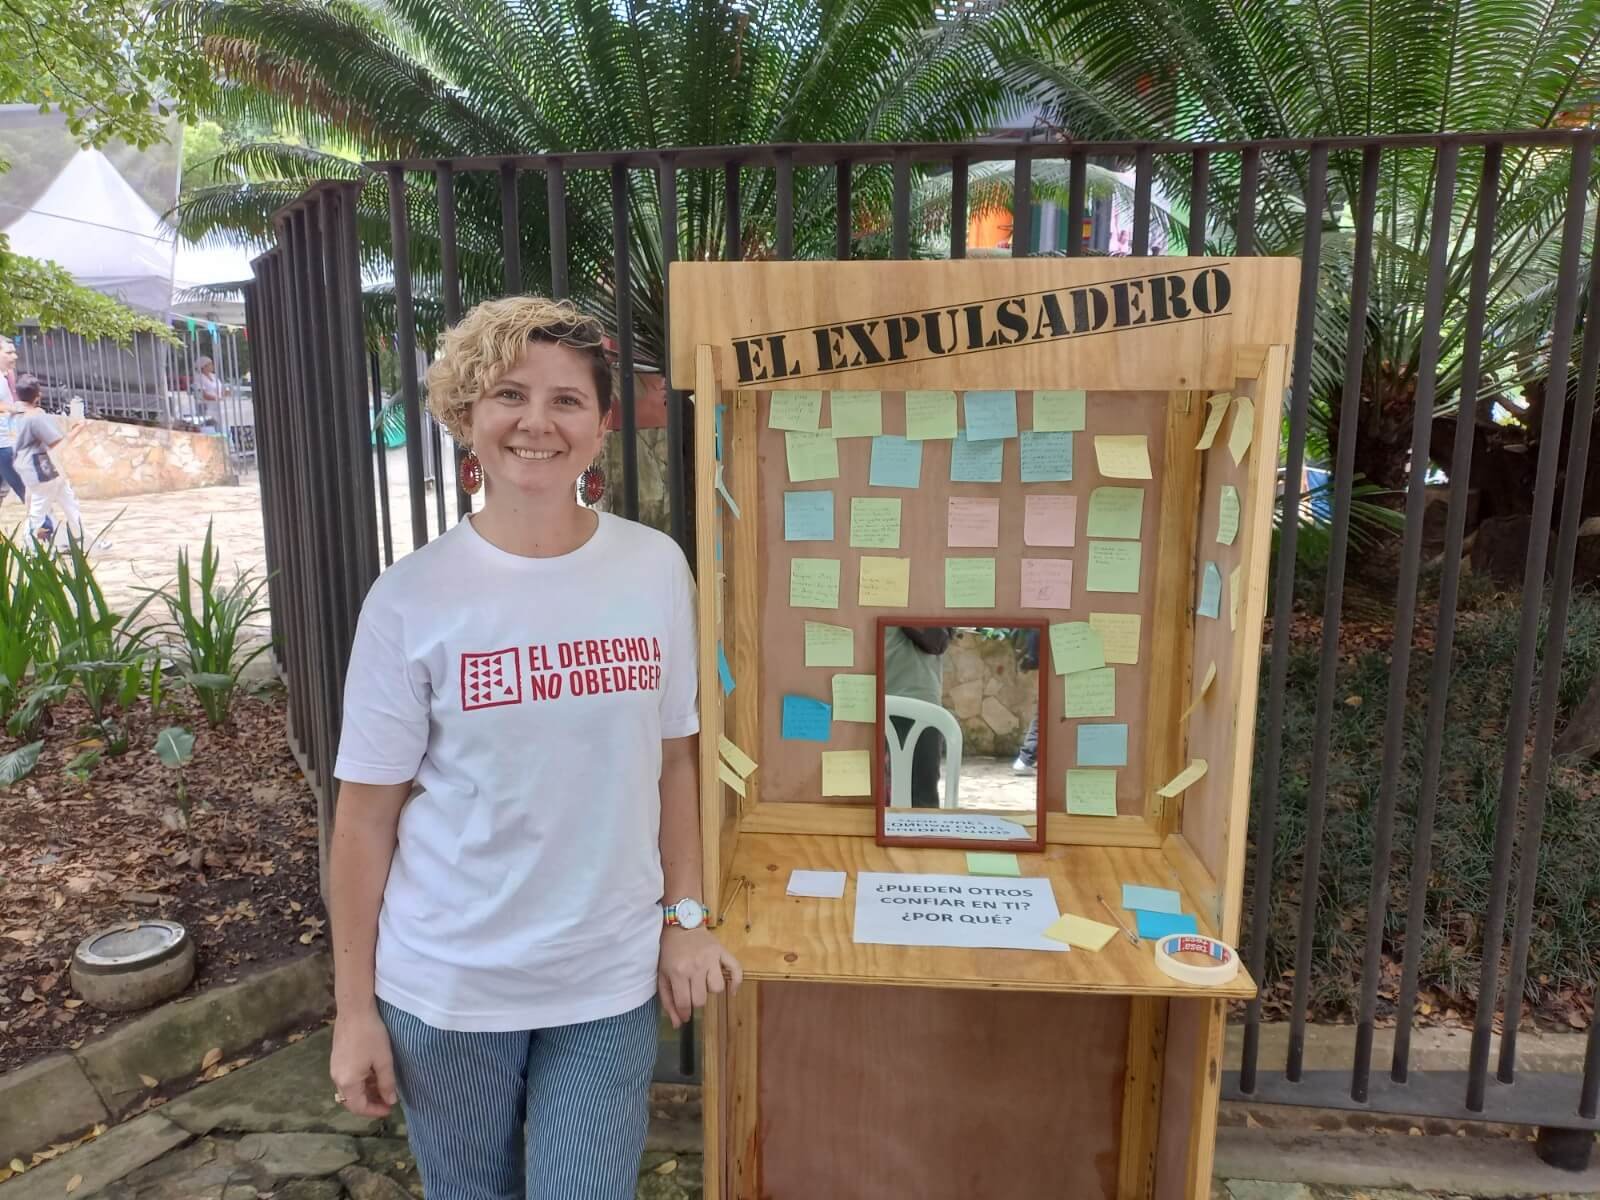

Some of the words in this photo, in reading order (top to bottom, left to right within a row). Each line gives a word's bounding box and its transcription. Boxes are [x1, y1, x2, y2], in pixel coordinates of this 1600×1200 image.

[732, 335, 801, 382] EL
[813, 268, 1232, 371] EXPULSADERO
[529, 645, 553, 671] EL
[558, 637, 650, 668] DERECHO
[653, 637, 661, 662] A
[531, 673, 562, 701] NO
[568, 665, 661, 696] OBEDECER
[876, 885, 962, 894] ¿PUEDEN
[968, 887, 1033, 898] OTROS
[880, 897, 965, 908] CONFIAR
[972, 901, 997, 910] EN
[1003, 902, 1031, 911] TI?
[901, 912, 953, 923] ¿POR
[959, 914, 1013, 926] QUÉ?
